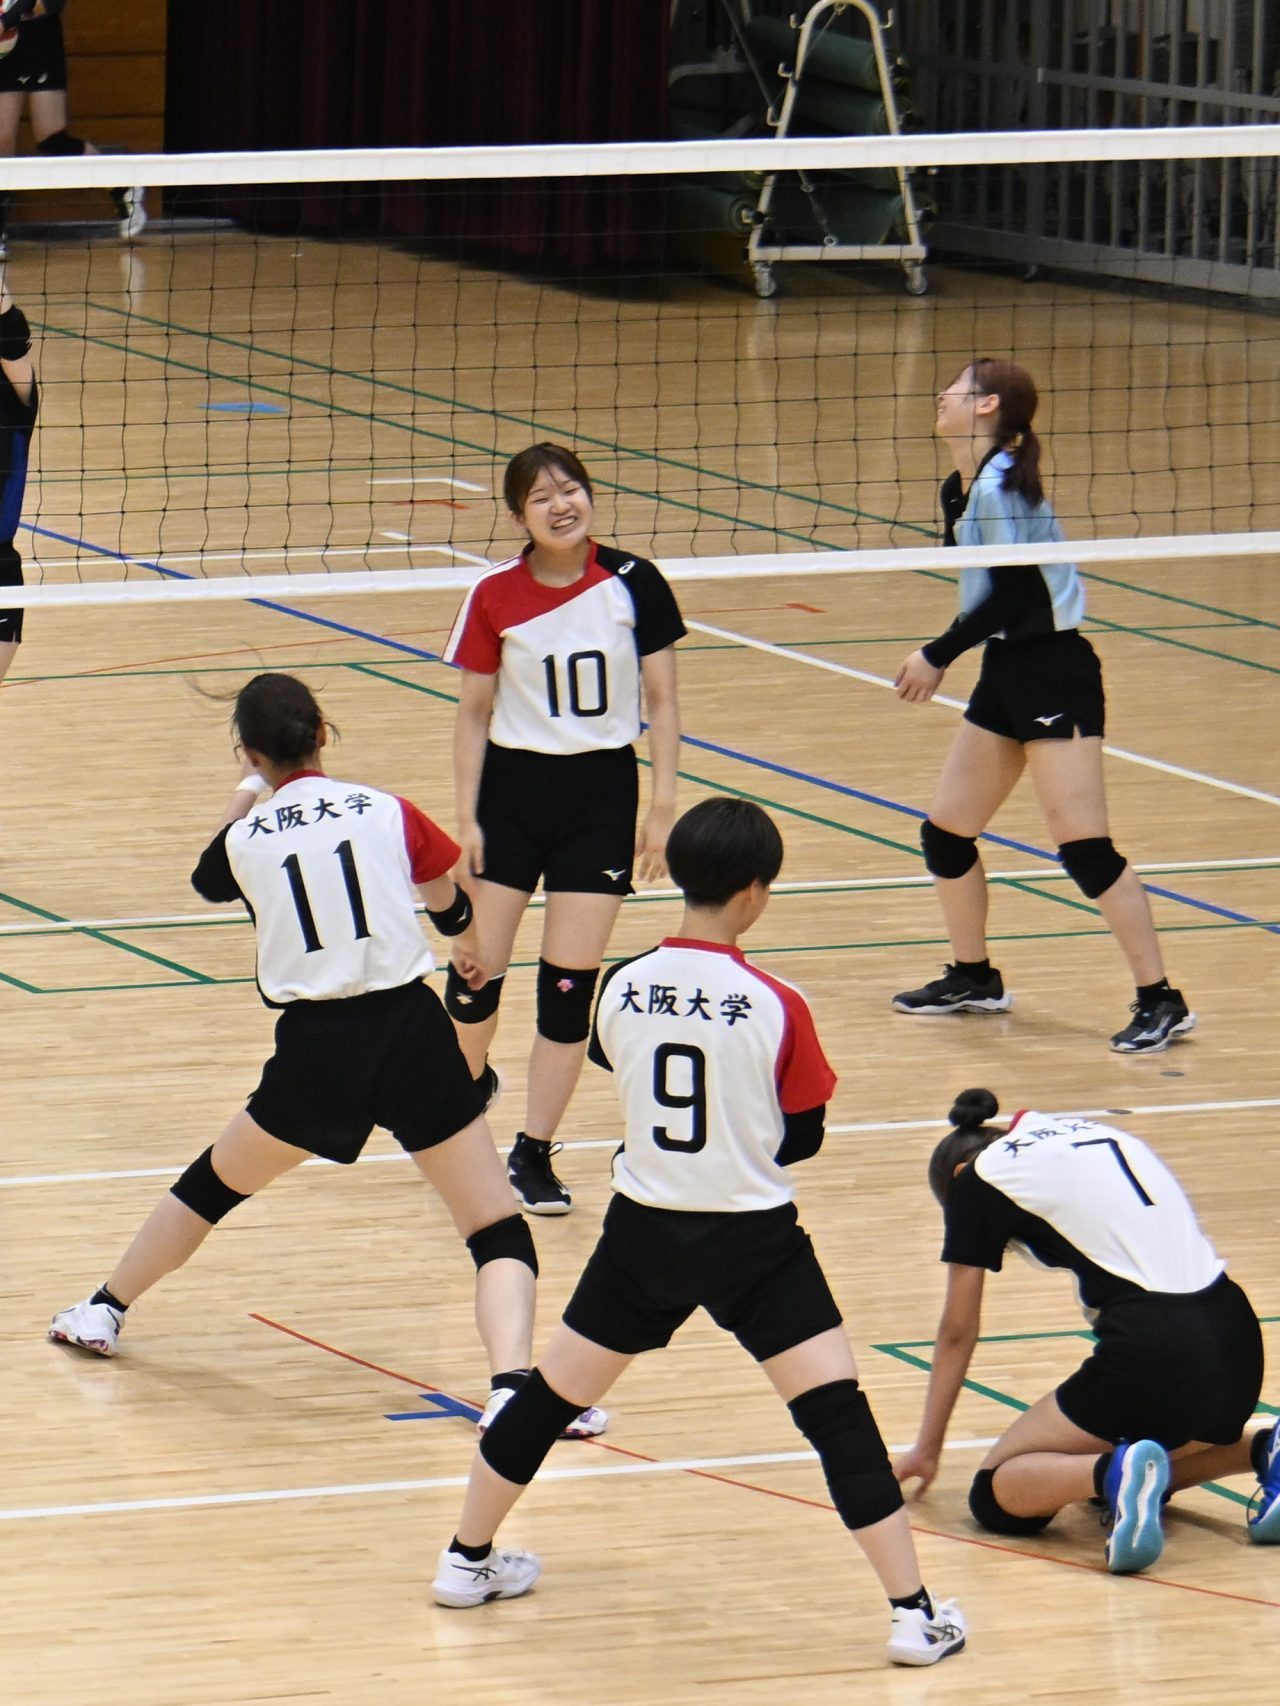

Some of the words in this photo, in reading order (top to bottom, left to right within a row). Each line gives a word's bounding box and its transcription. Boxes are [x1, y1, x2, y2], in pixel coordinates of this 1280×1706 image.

[541, 649, 609, 718] 10
[247, 792, 373, 839] 大阪大学
[281, 839, 372, 954] 11
[618, 982, 753, 1027] 大阪大学
[652, 1042, 707, 1154] 9
[1071, 1137, 1155, 1207] 7
